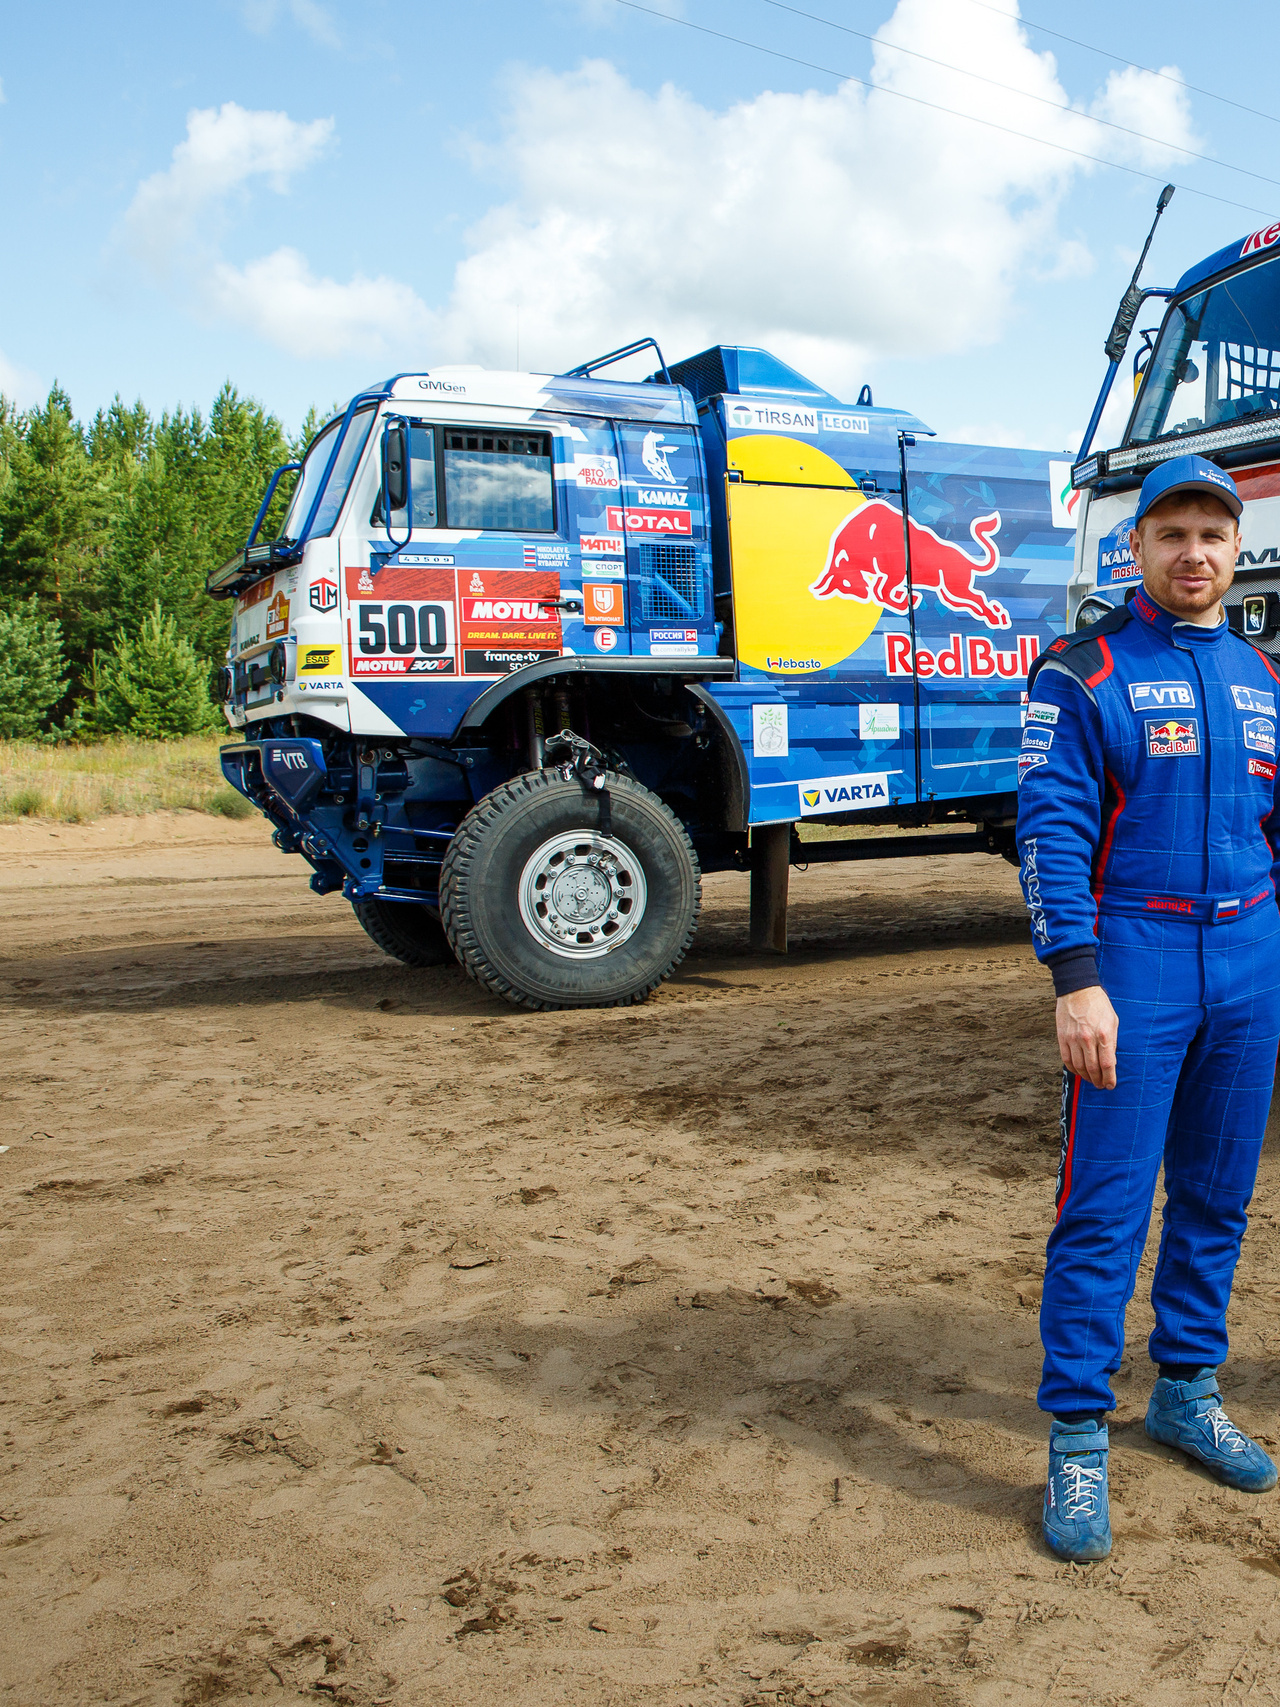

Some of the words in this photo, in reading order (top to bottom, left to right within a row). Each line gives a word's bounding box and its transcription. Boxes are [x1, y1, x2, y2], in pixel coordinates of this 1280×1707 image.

[418, 380, 467, 393] GMGen
[824, 416, 868, 431] LEONI
[577, 468, 604, 478] АВТО
[585, 476, 618, 487] РАДИО
[637, 490, 689, 506] KAMAZ
[610, 510, 688, 531] TOTAL
[1101, 549, 1135, 568] KAM
[358, 604, 447, 654] 500
[467, 631, 501, 639] DREAM.
[502, 632, 527, 640] DARE.
[528, 632, 546, 640] LIVE
[653, 632, 683, 640] РОССИЯ
[686, 632, 696, 640] 24
[306, 655, 330, 663] ESAB
[886, 634, 963, 677] Red
[968, 635, 1039, 678] Bull
[355, 660, 407, 672] MOTUL
[410, 659, 453, 671] 300V
[766, 657, 821, 669] Webasto
[308, 681, 344, 690] VARTA
[1151, 686, 1191, 704] VTB
[1027, 712, 1056, 722] ATNEFT
[1151, 741, 1174, 755] Red
[1174, 740, 1197, 753] Bull
[282, 752, 308, 770] VTB
[1255, 764, 1274, 777] TOTAL
[824, 782, 886, 803] VARTA
